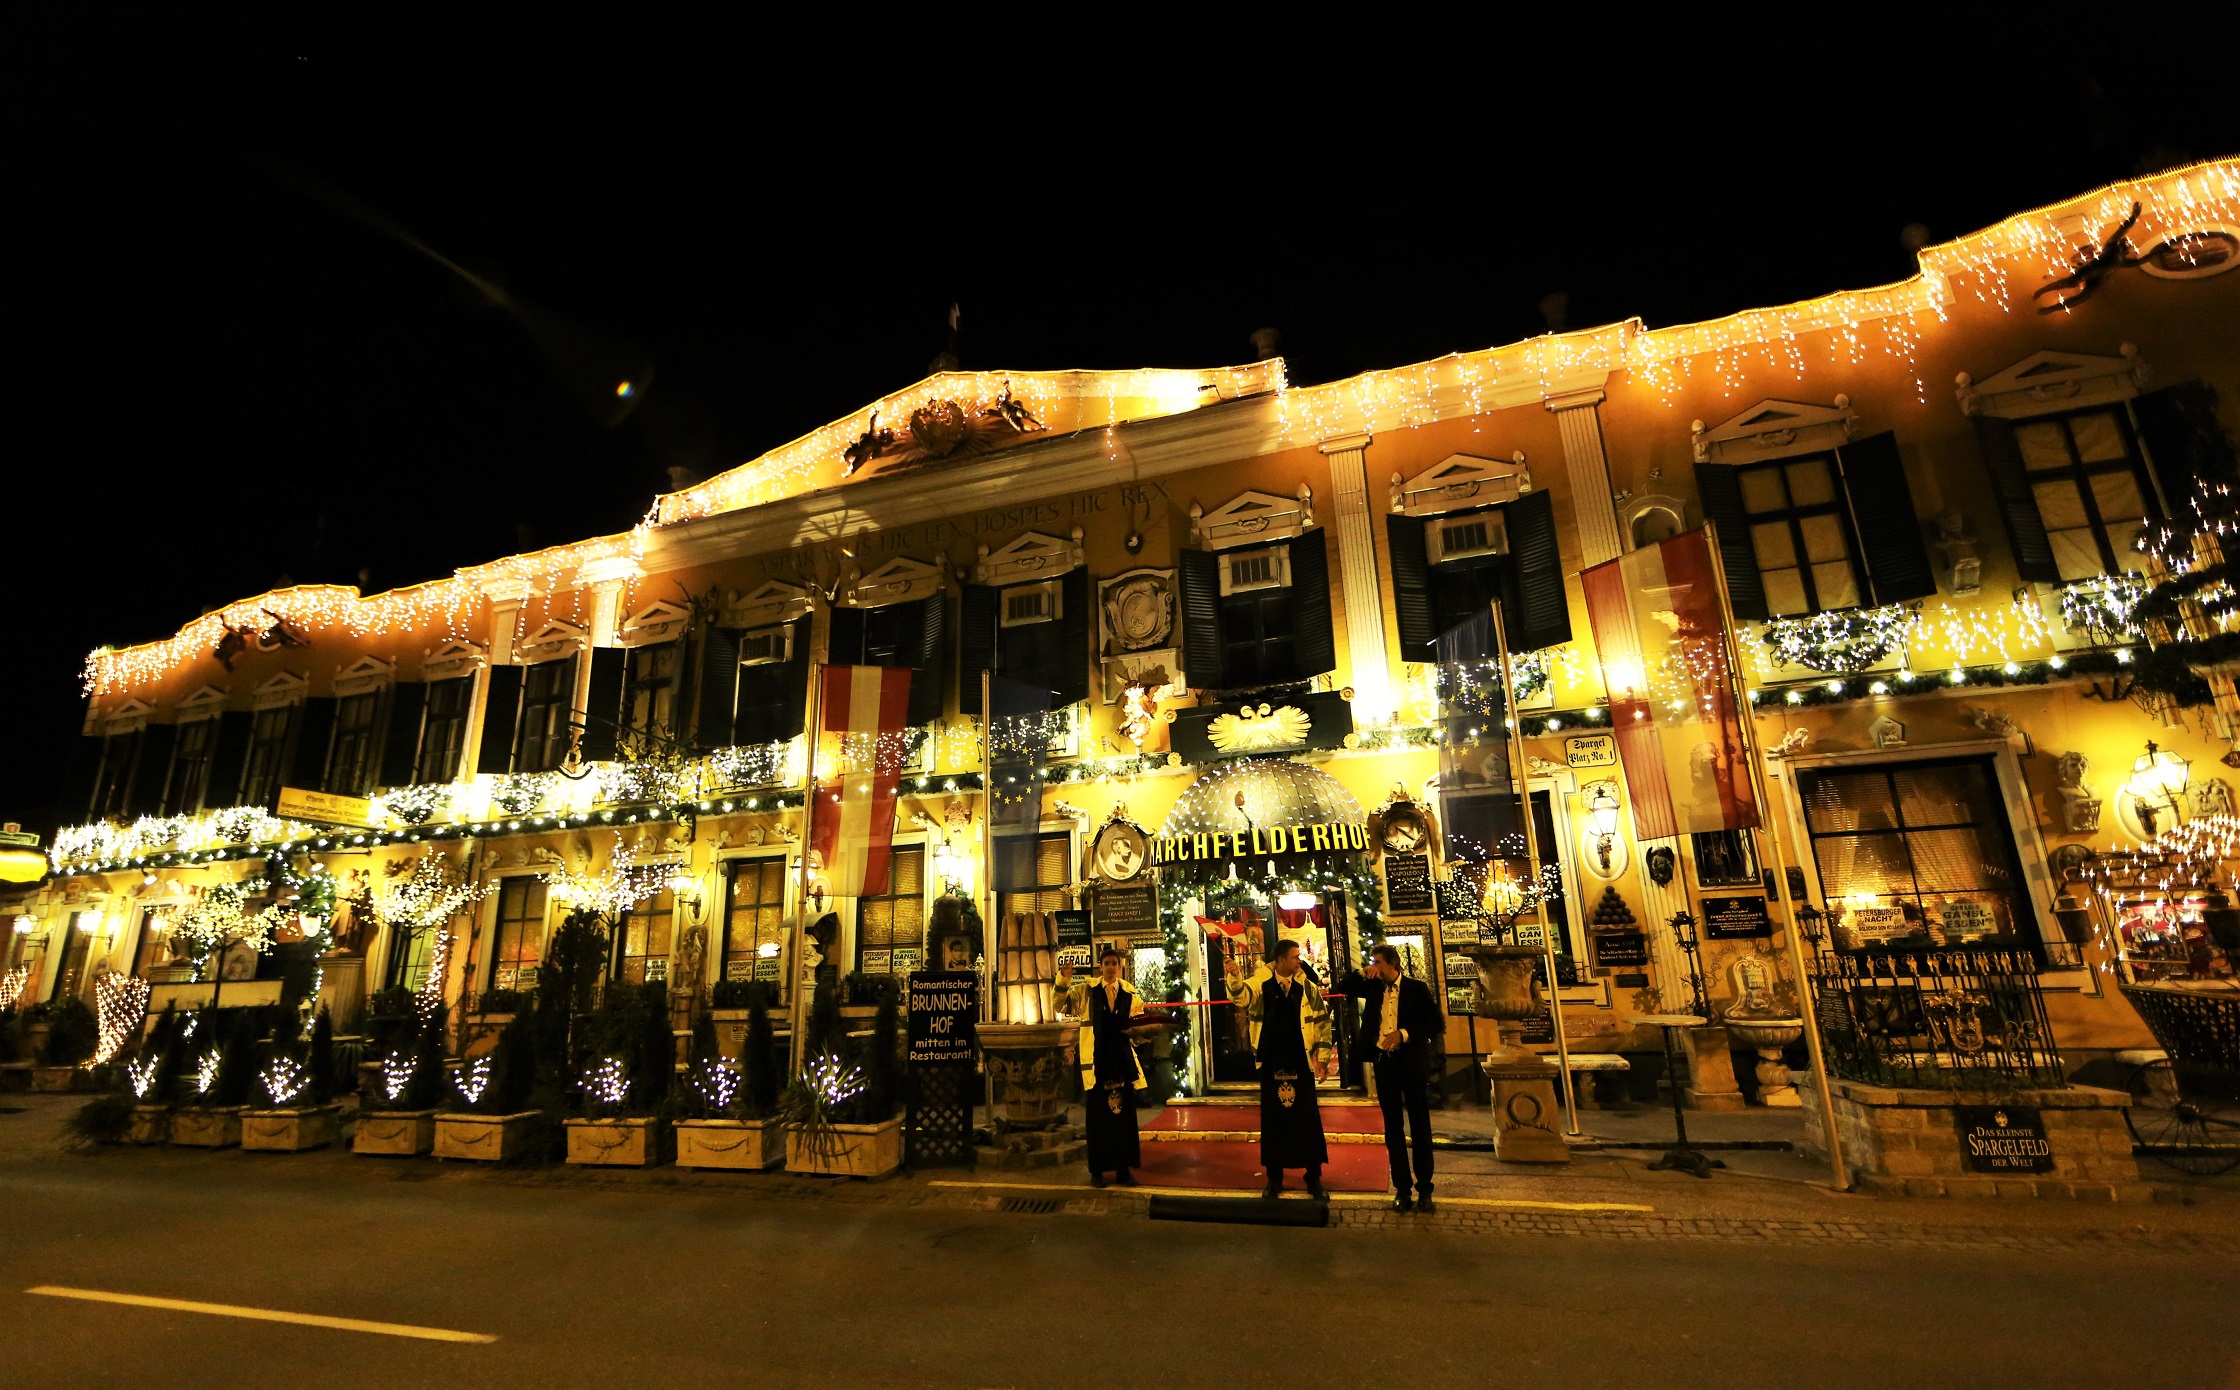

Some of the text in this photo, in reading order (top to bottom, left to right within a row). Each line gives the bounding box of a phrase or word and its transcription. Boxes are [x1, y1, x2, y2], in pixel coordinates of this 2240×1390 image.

[974, 502, 1061, 534] HOSPES
[1070, 491, 1109, 517] HIC
[1122, 479, 1170, 506] REX
[1573, 738, 1605, 751] Spargel
[1568, 752, 1590, 764] Platz
[1854, 908, 1901, 917] PETERSBURGER
[1942, 910, 1991, 919] GANSL-
[1945, 919, 1985, 929] ESSEN
[912, 980, 973, 990] Romantischer
[911, 993, 973, 1012] BRUNNEN-
[930, 1016, 954, 1034] HOF
[915, 1037, 967, 1048] mitten im
[909, 1048, 972, 1061] Restaurant!
